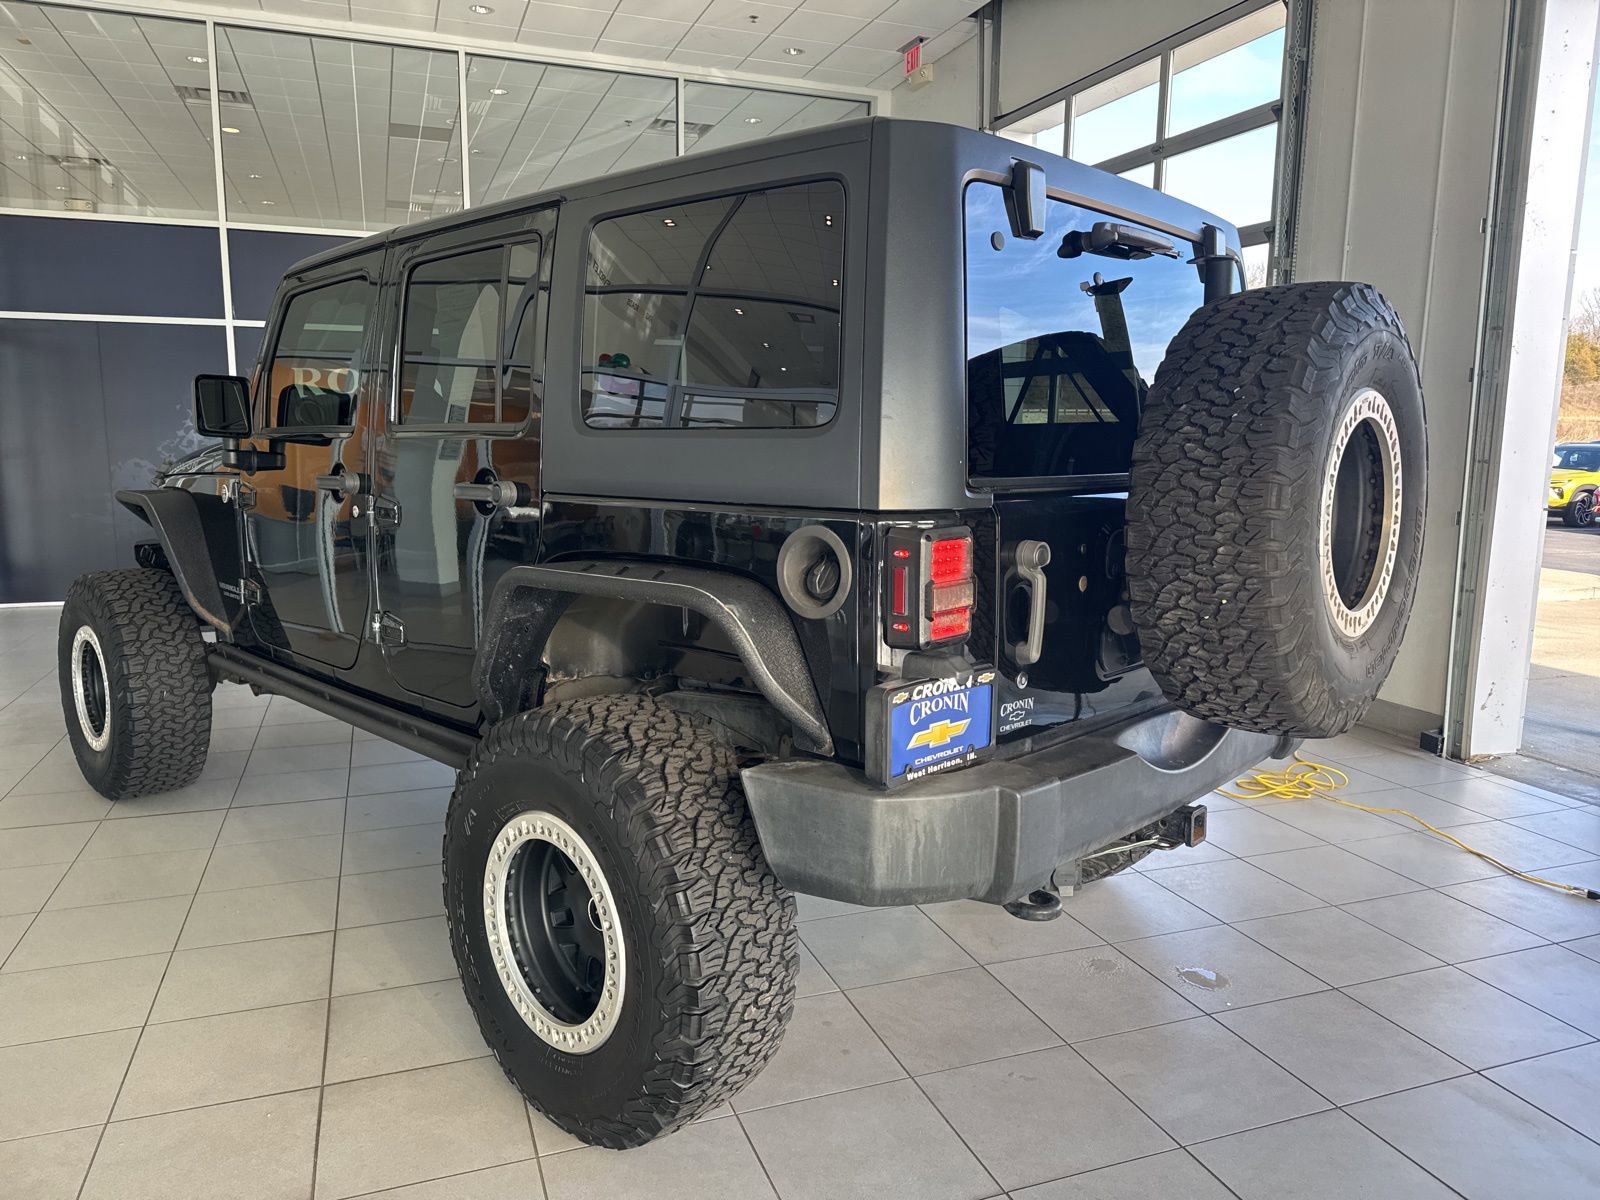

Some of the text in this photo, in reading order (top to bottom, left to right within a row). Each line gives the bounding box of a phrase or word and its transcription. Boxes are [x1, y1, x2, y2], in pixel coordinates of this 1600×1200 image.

[910, 691, 970, 726] CRONIN
[1000, 696, 1034, 717] CRONIN
[1000, 718, 1032, 732] CHEVROLET
[914, 746, 964, 765] CHEVROLET
[906, 768, 926, 781] West
